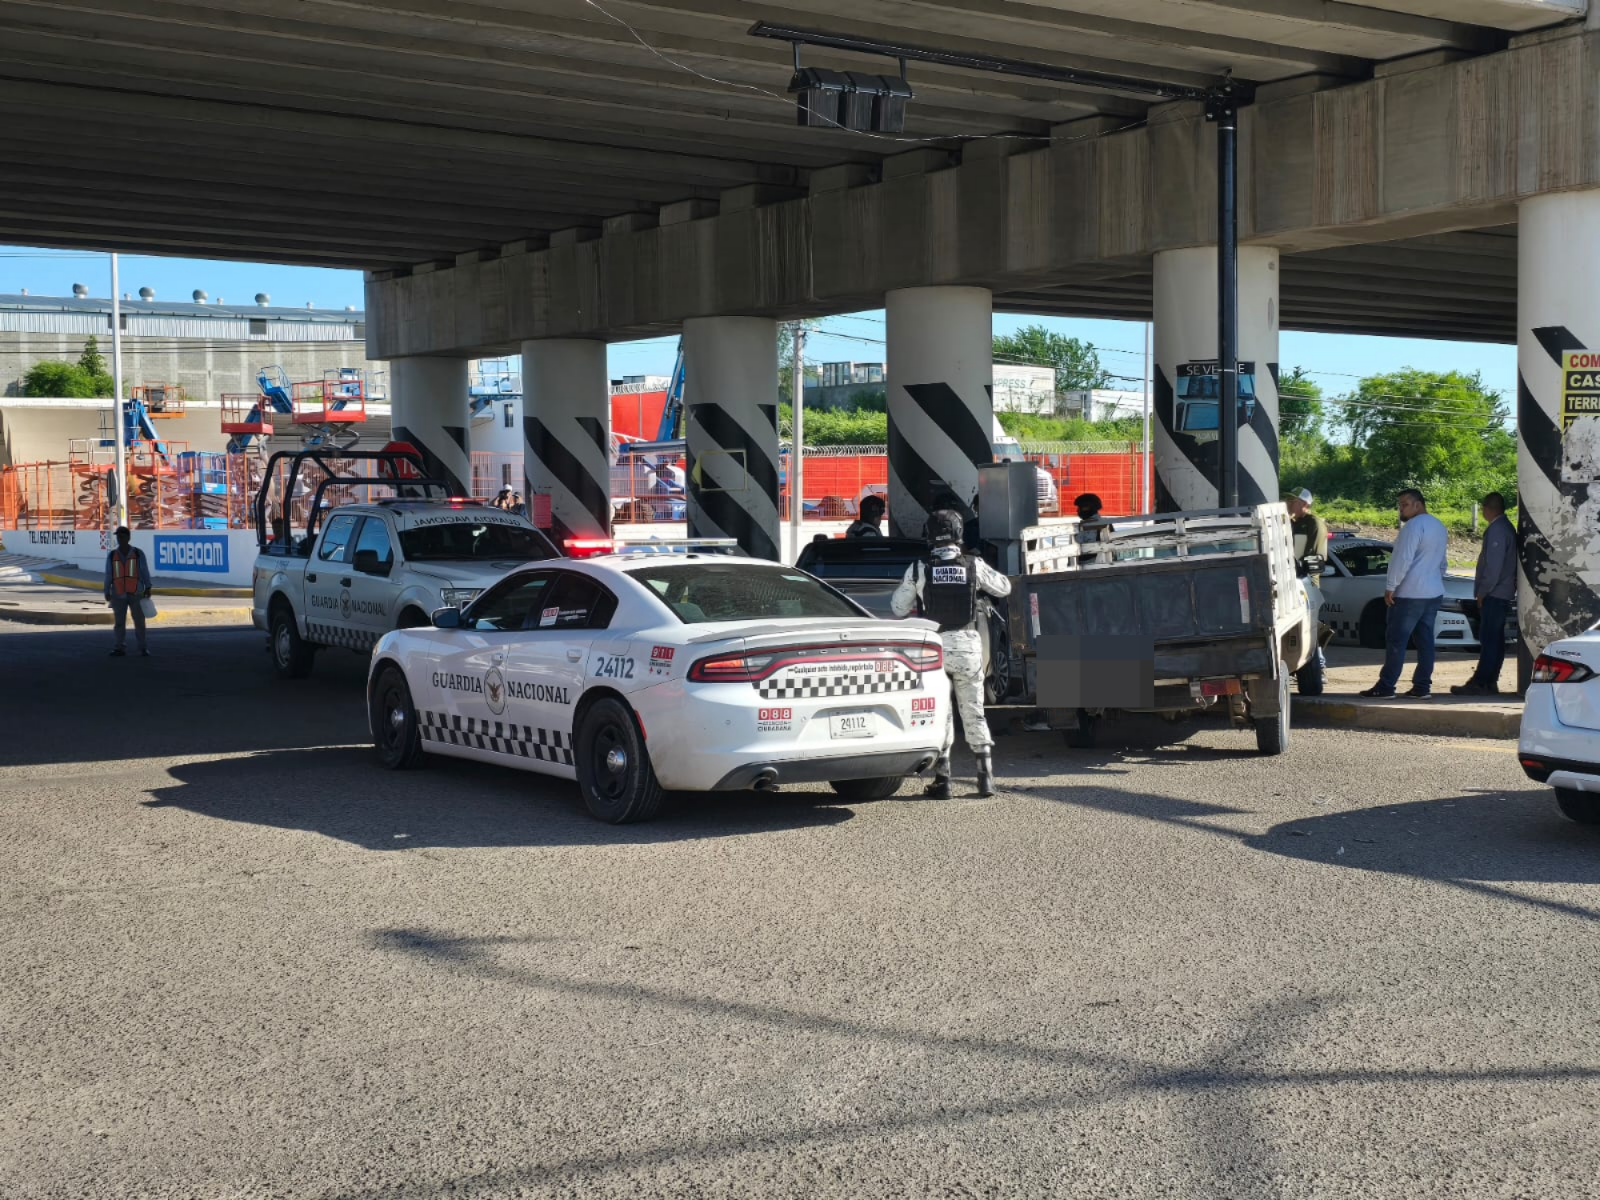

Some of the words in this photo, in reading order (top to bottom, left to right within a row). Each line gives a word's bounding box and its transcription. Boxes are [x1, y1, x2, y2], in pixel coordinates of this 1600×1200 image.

[1186, 365, 1200, 376] SE
[1203, 363, 1245, 376] VEE
[1567, 396, 1600, 410] TERR
[935, 567, 964, 575] GUARDIA
[933, 575, 966, 583] NACIONAL
[311, 594, 339, 610] GUARDIA
[351, 599, 387, 616] NACIONAL
[1320, 602, 1344, 613] NAL
[652, 646, 674, 659] 911
[595, 656, 635, 679] 24112
[794, 666, 817, 674] Cualquier
[432, 671, 483, 693] GUARDIA
[507, 680, 571, 704] NACIONAL
[912, 698, 935, 711] 911
[760, 708, 792, 720] 088
[841, 716, 866, 730] 24112
